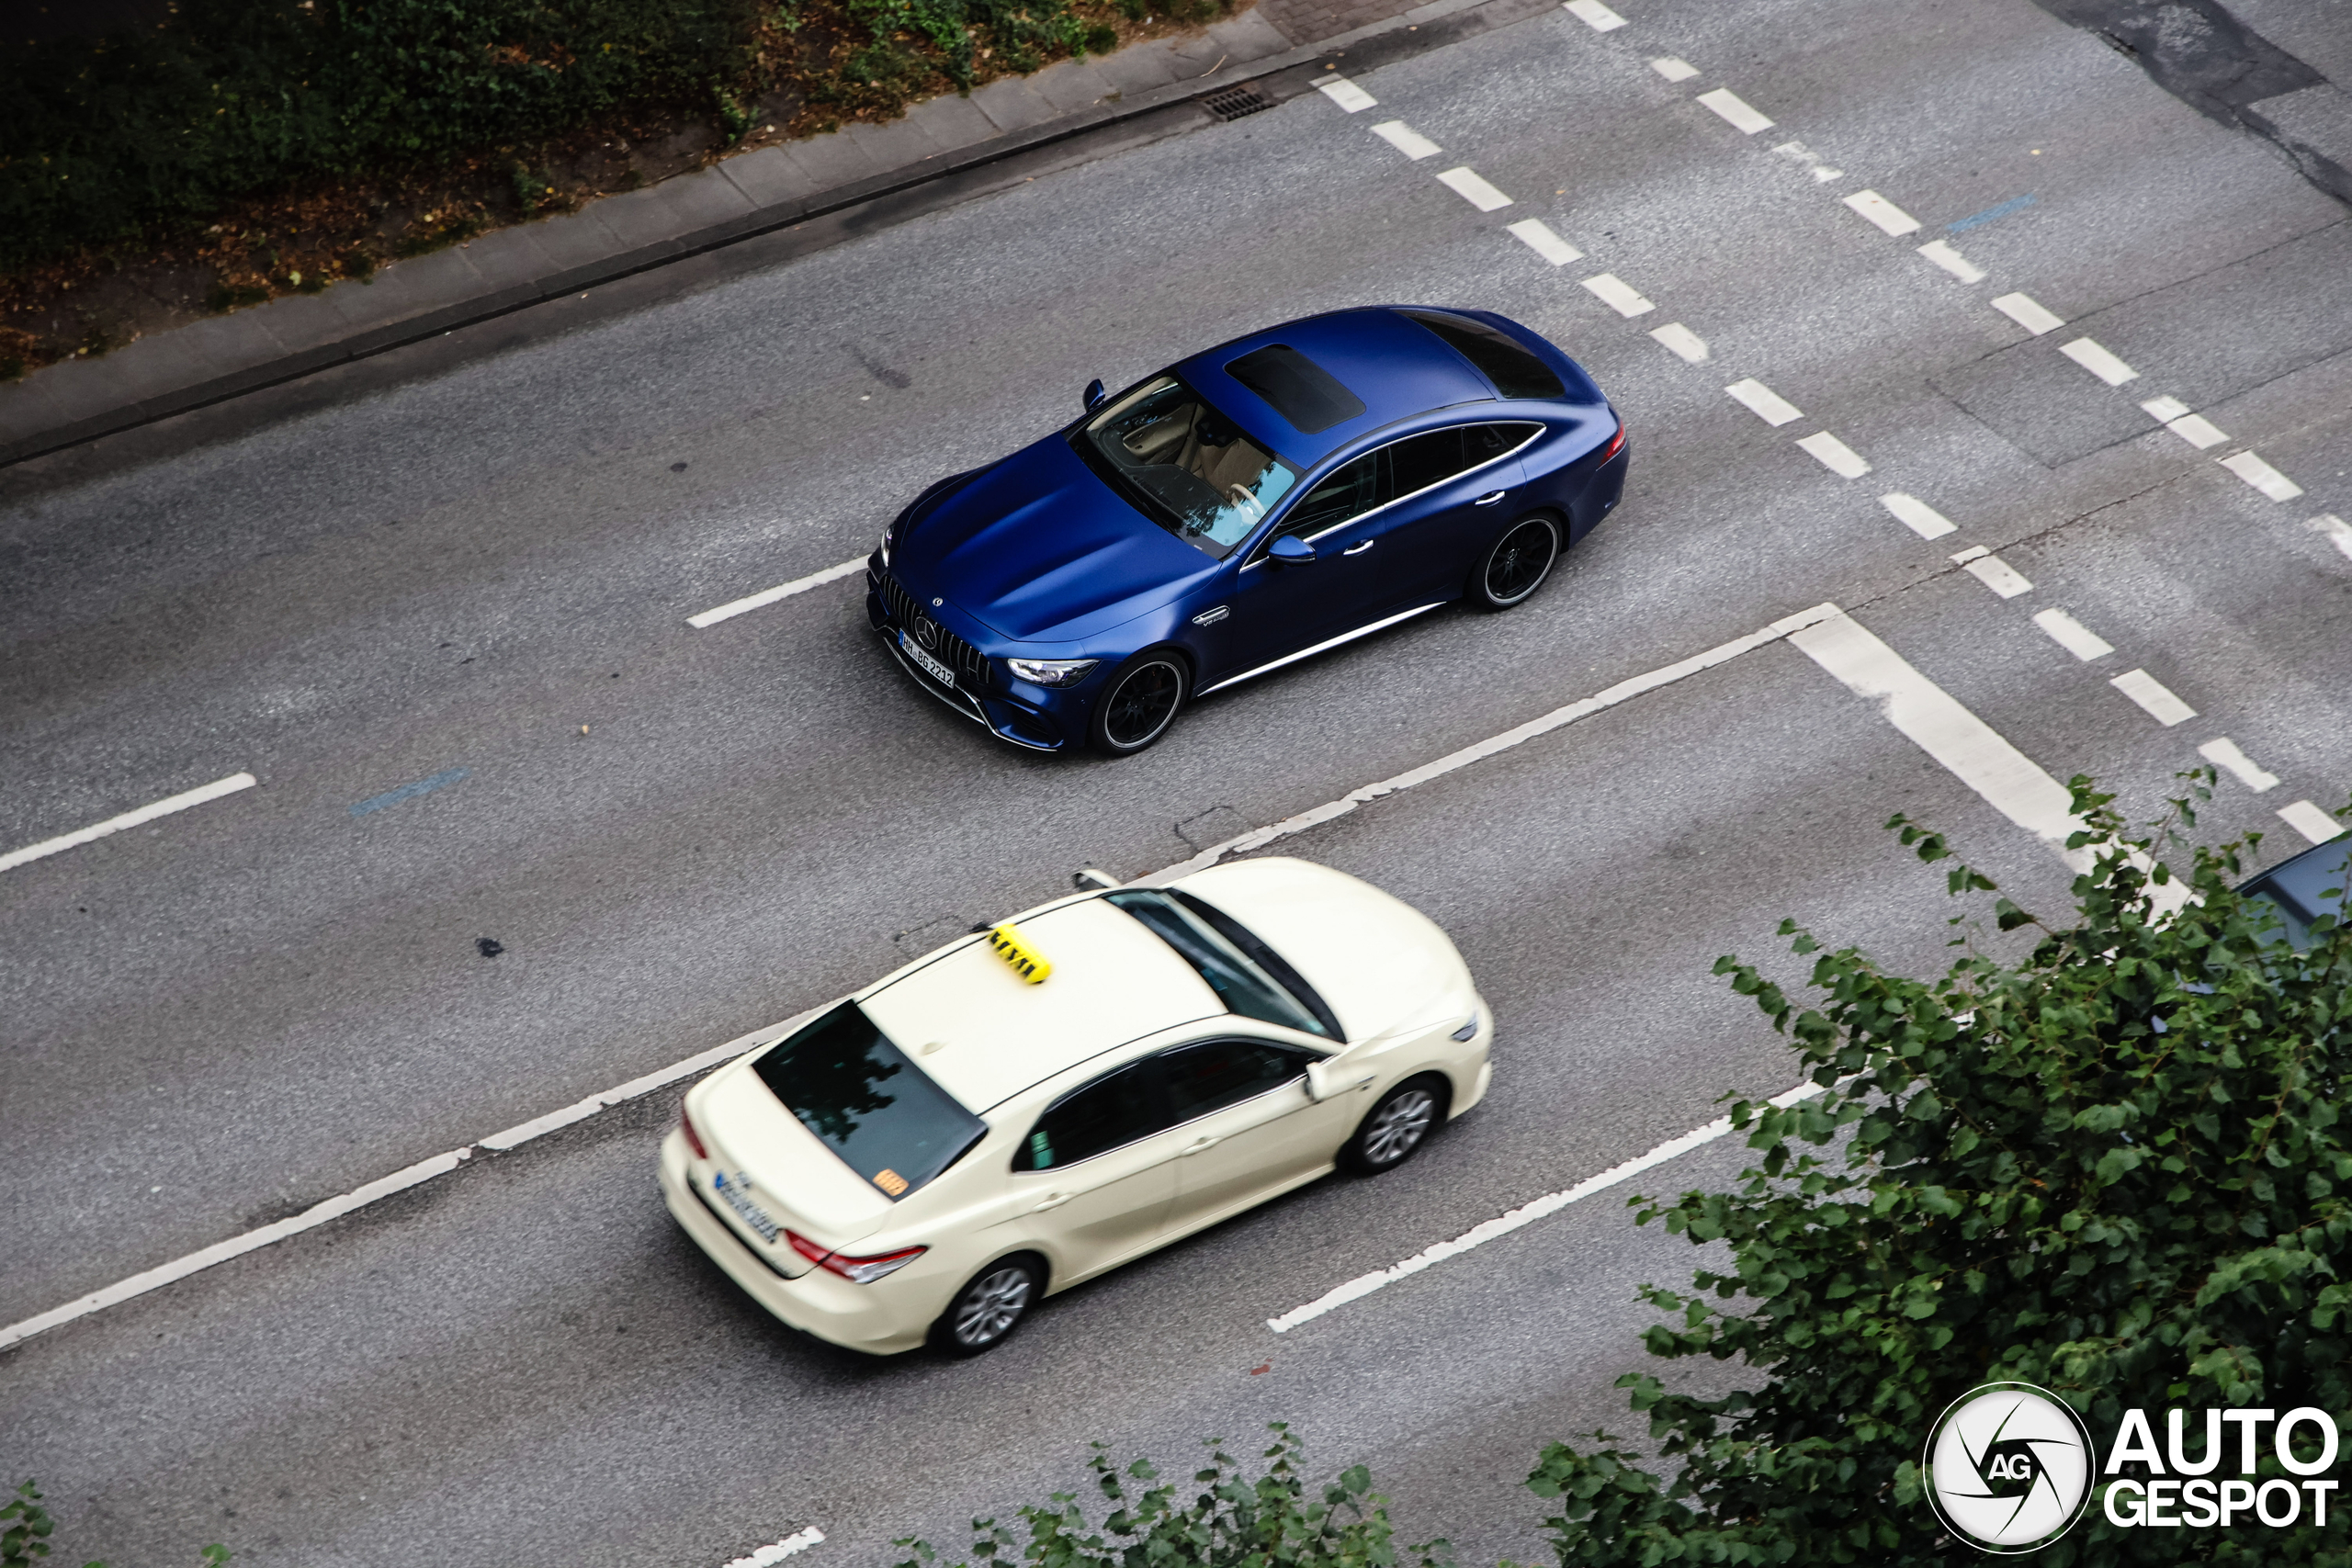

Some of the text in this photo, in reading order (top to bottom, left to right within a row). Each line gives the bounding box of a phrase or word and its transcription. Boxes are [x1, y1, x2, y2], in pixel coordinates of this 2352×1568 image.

[903, 636, 953, 686] HH BG 2212
